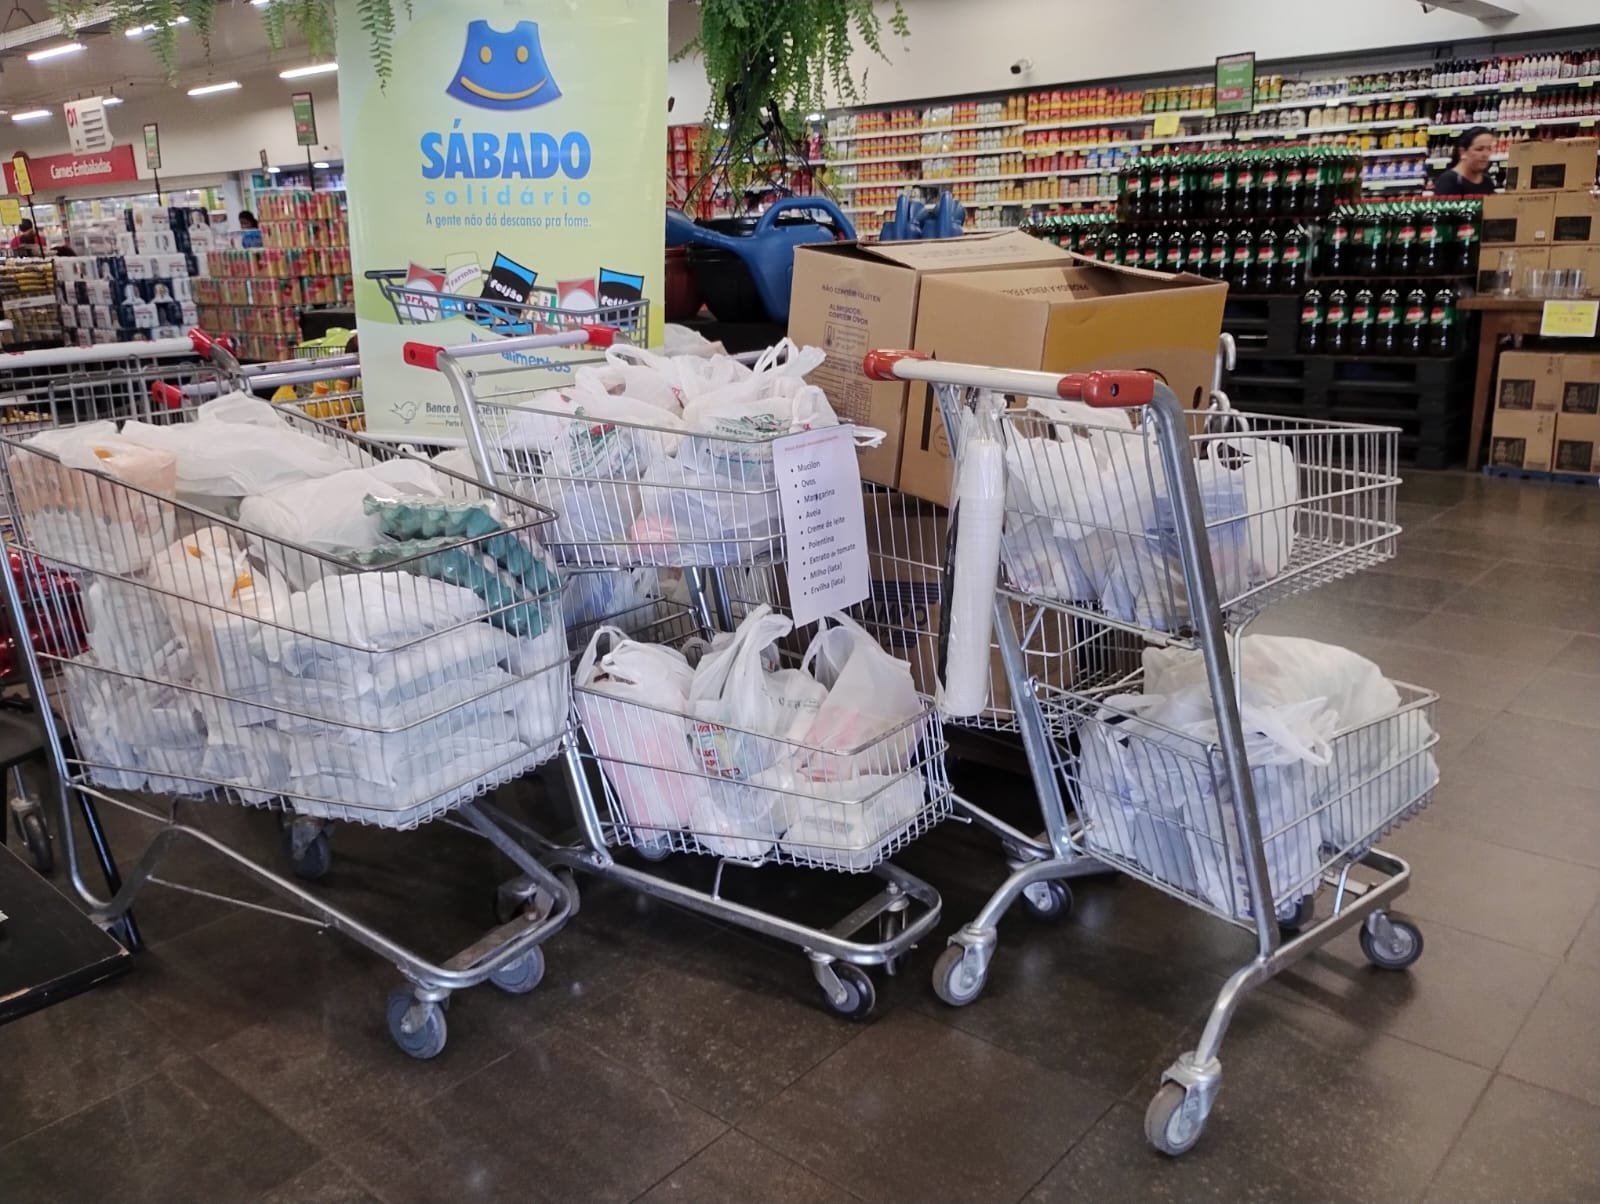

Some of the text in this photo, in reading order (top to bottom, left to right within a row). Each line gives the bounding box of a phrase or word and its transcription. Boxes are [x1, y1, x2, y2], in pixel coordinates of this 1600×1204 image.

[420, 118, 592, 180] SÁBADO
[425, 184, 592, 206] solidário
[425, 213, 592, 228] A gente não dá descanso pra fome.
[490, 279, 524, 303] feijão
[426, 402, 451, 413] Banco
[801, 479, 816, 488] Ovos
[806, 508, 821, 518] Aveia
[807, 517, 845, 534] Creme de leite
[808, 536, 834, 549] Polentina
[809, 553, 830, 564] Extrato
[837, 544, 856, 554] tomate
[810, 561, 842, 579] Milho (lata)
[811, 576, 846, 594] Ervilha (lata)
